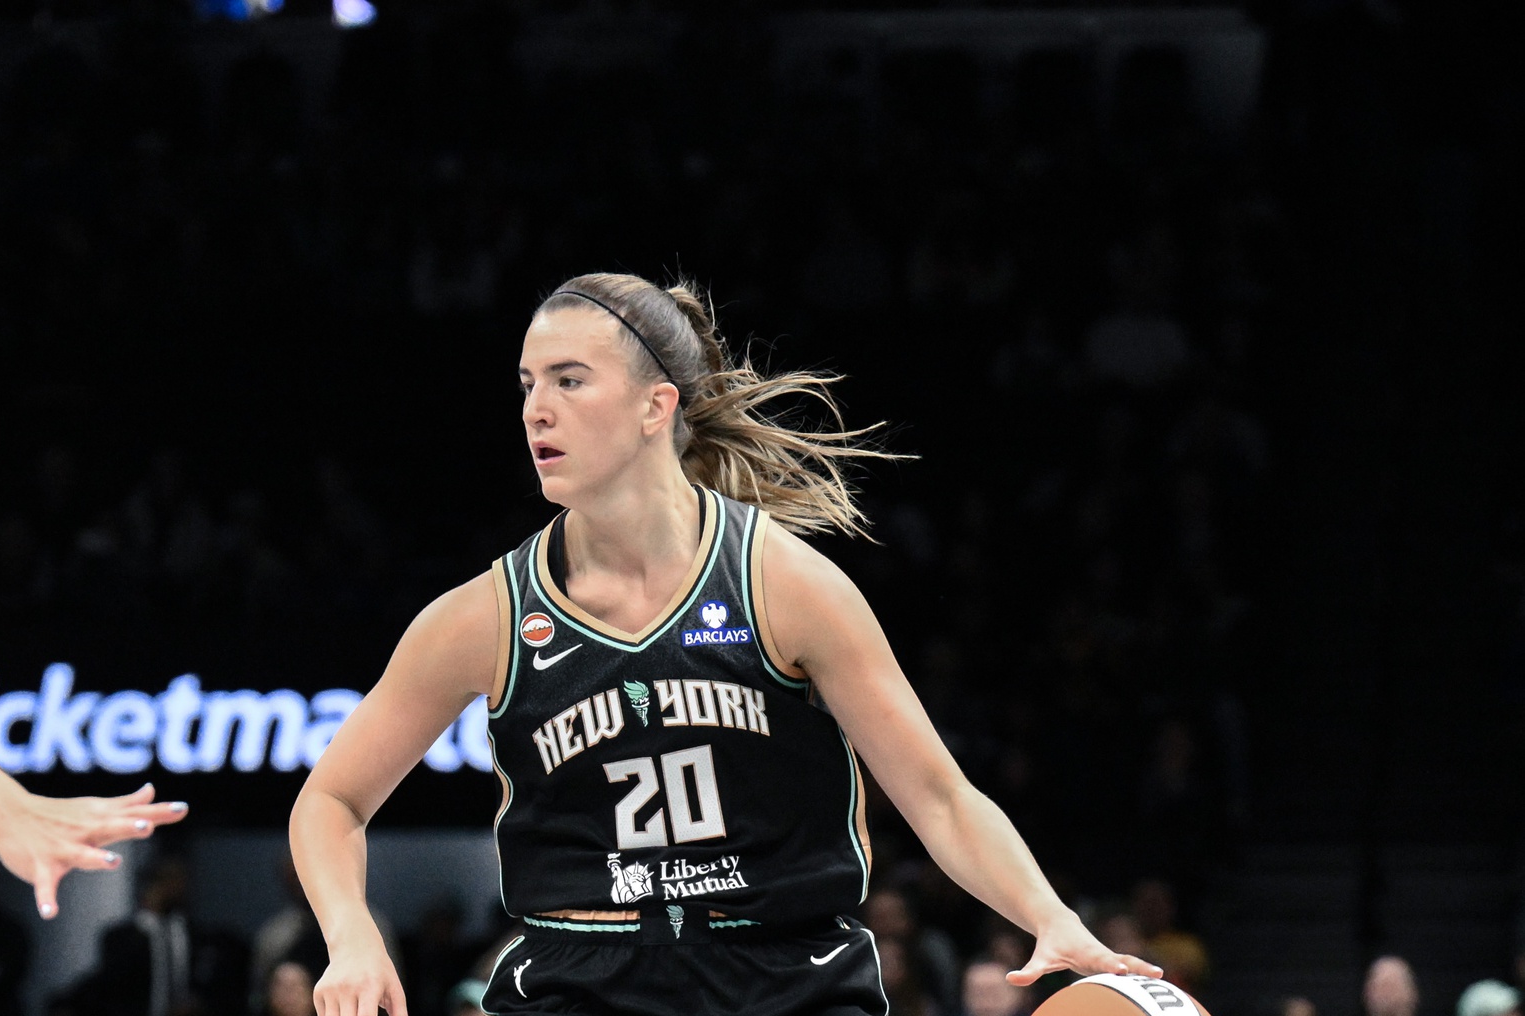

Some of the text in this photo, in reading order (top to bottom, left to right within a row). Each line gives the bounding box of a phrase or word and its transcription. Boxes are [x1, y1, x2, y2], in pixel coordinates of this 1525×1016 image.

[684, 629, 749, 646] BARCLAYS
[531, 679, 771, 775] NEW YORK
[602, 744, 727, 850] 20
[660, 854, 740, 882] Liberty
[662, 872, 749, 900] Mutual
